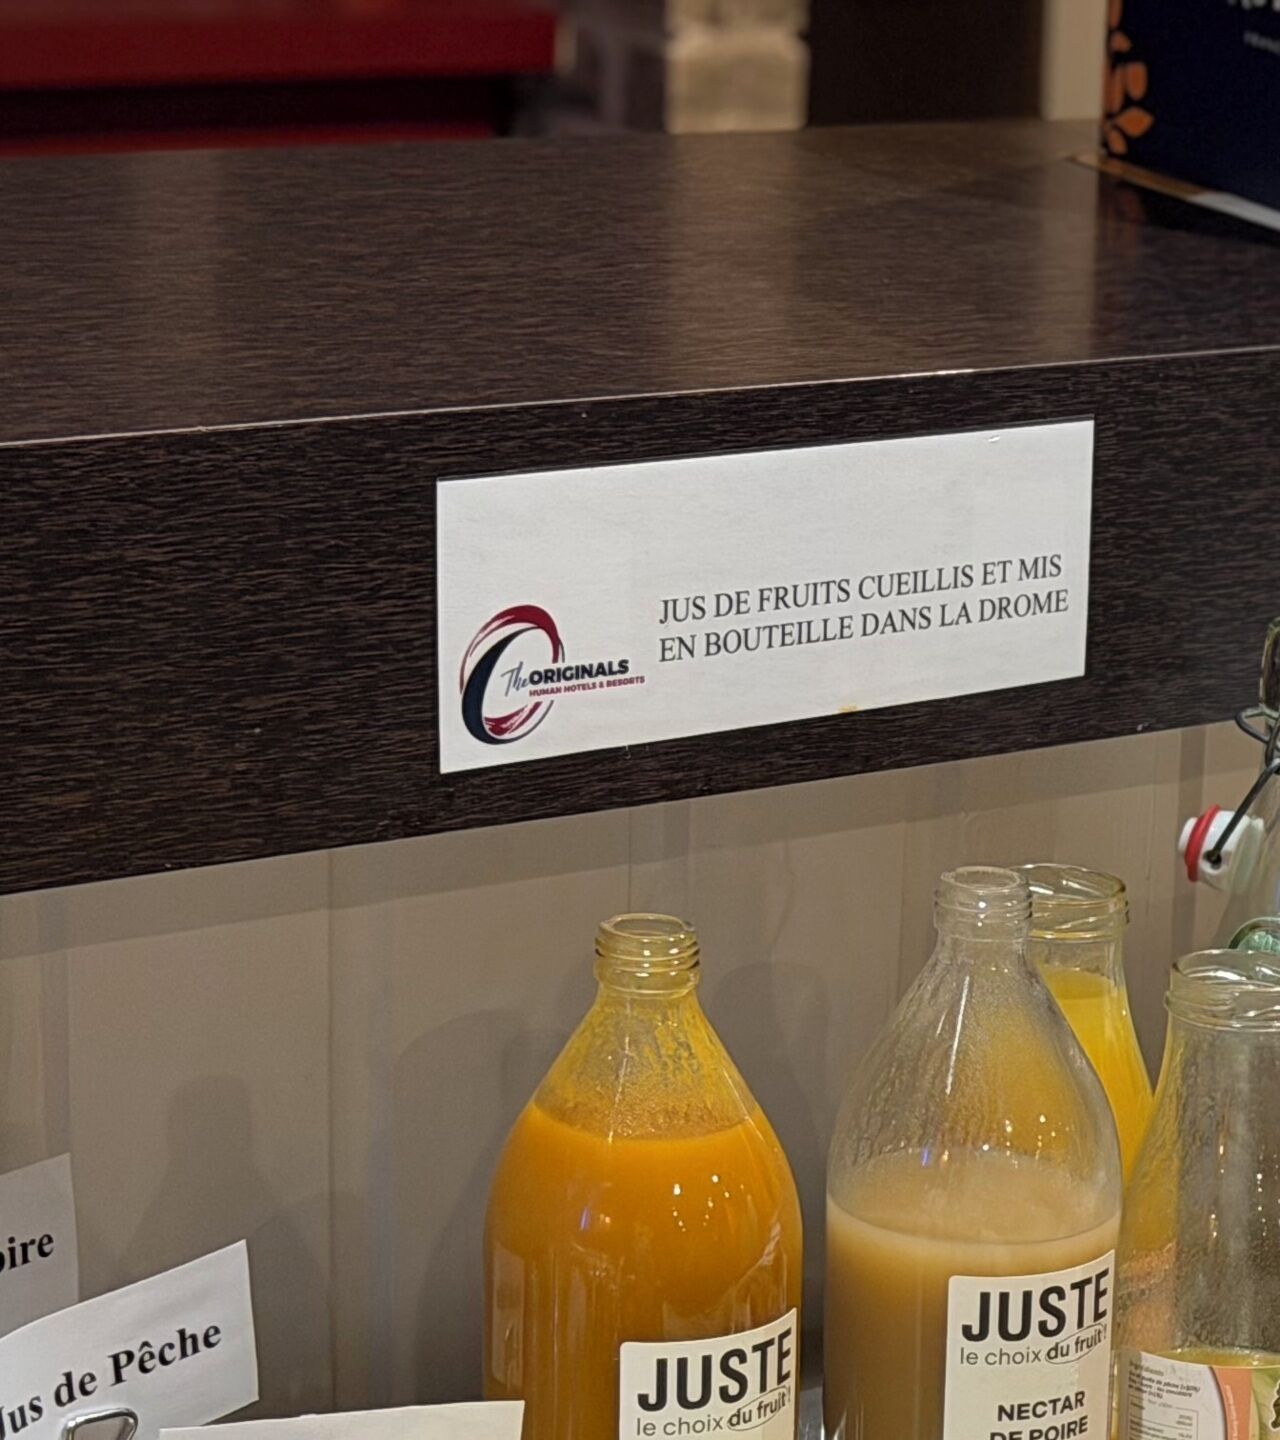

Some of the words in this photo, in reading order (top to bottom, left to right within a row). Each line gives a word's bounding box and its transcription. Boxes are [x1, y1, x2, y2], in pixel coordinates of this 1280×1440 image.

[659, 594, 706, 625] JUS
[713, 590, 751, 617] DE
[758, 579, 851, 612] FRUITS
[858, 565, 975, 601] CUEILLIS
[981, 560, 1012, 585] ET
[1018, 553, 1063, 582] MIS
[659, 634, 697, 663] EN
[705, 616, 854, 658] BOUTEILLE
[861, 608, 932, 637] DANS
[940, 603, 972, 628] LA
[978, 588, 1069, 621] DROME
[501, 661, 529, 697] The
[529, 659, 630, 685] ORIGINALS
[529, 686, 562, 697] HUMAN
[564, 682, 597, 693] HOTELS
[606, 676, 645, 688] RESORTS
[961, 1267, 1110, 1342] JUSTE
[54, 1365, 98, 1408] de
[107, 1324, 223, 1389] Pêche
[636, 1326, 793, 1412] JUSTE
[960, 1347, 979, 1366] le
[985, 1346, 1042, 1365] choix
[1046, 1342, 1070, 1360] du
[637, 1417, 656, 1437] le
[663, 1414, 724, 1436] choix
[729, 1408, 753, 1428] du
[997, 1391, 1086, 1422] NECTAR
